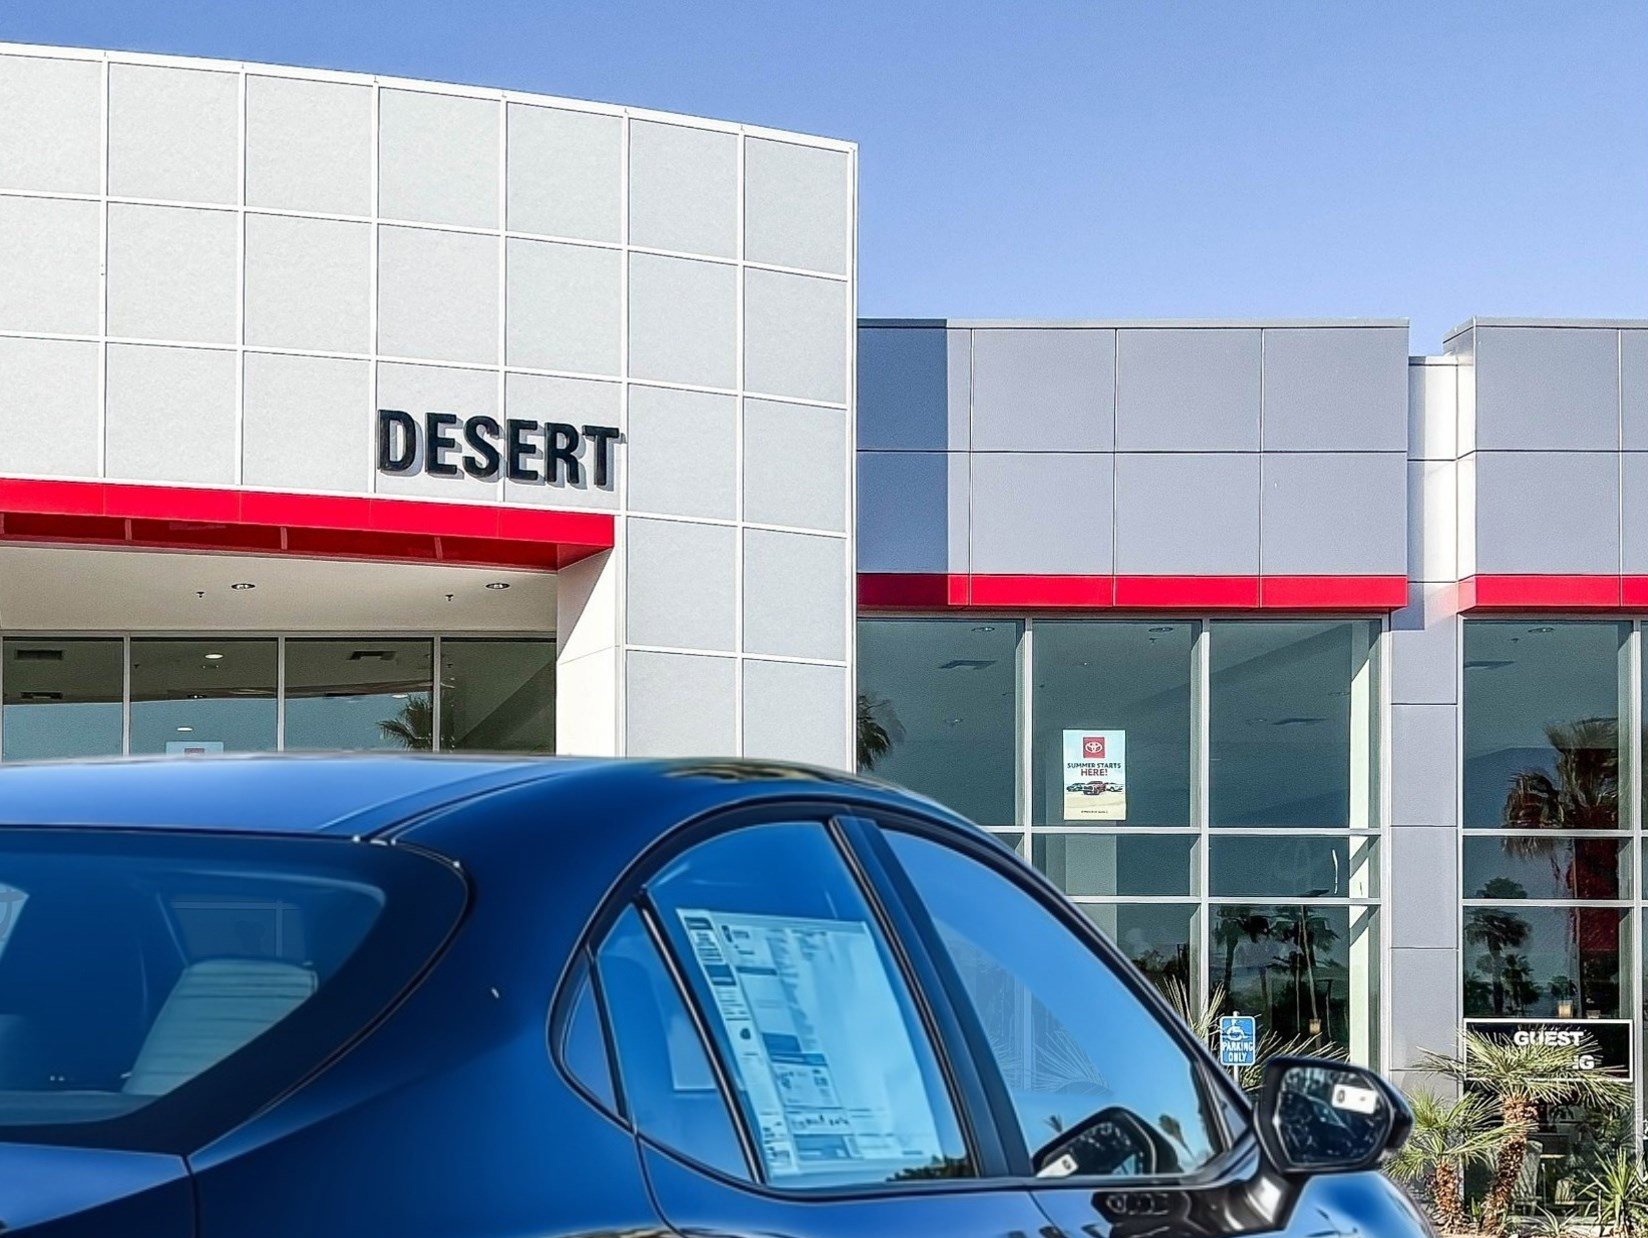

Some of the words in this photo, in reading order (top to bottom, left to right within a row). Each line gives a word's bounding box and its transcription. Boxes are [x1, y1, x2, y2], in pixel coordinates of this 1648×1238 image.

[377, 409, 620, 486] DESERT
[1080, 768, 1108, 776] HERE!
[1513, 1031, 1584, 1047] GUEST
[1222, 1041, 1254, 1052] PARKING
[1228, 1051, 1248, 1063] ONLY
